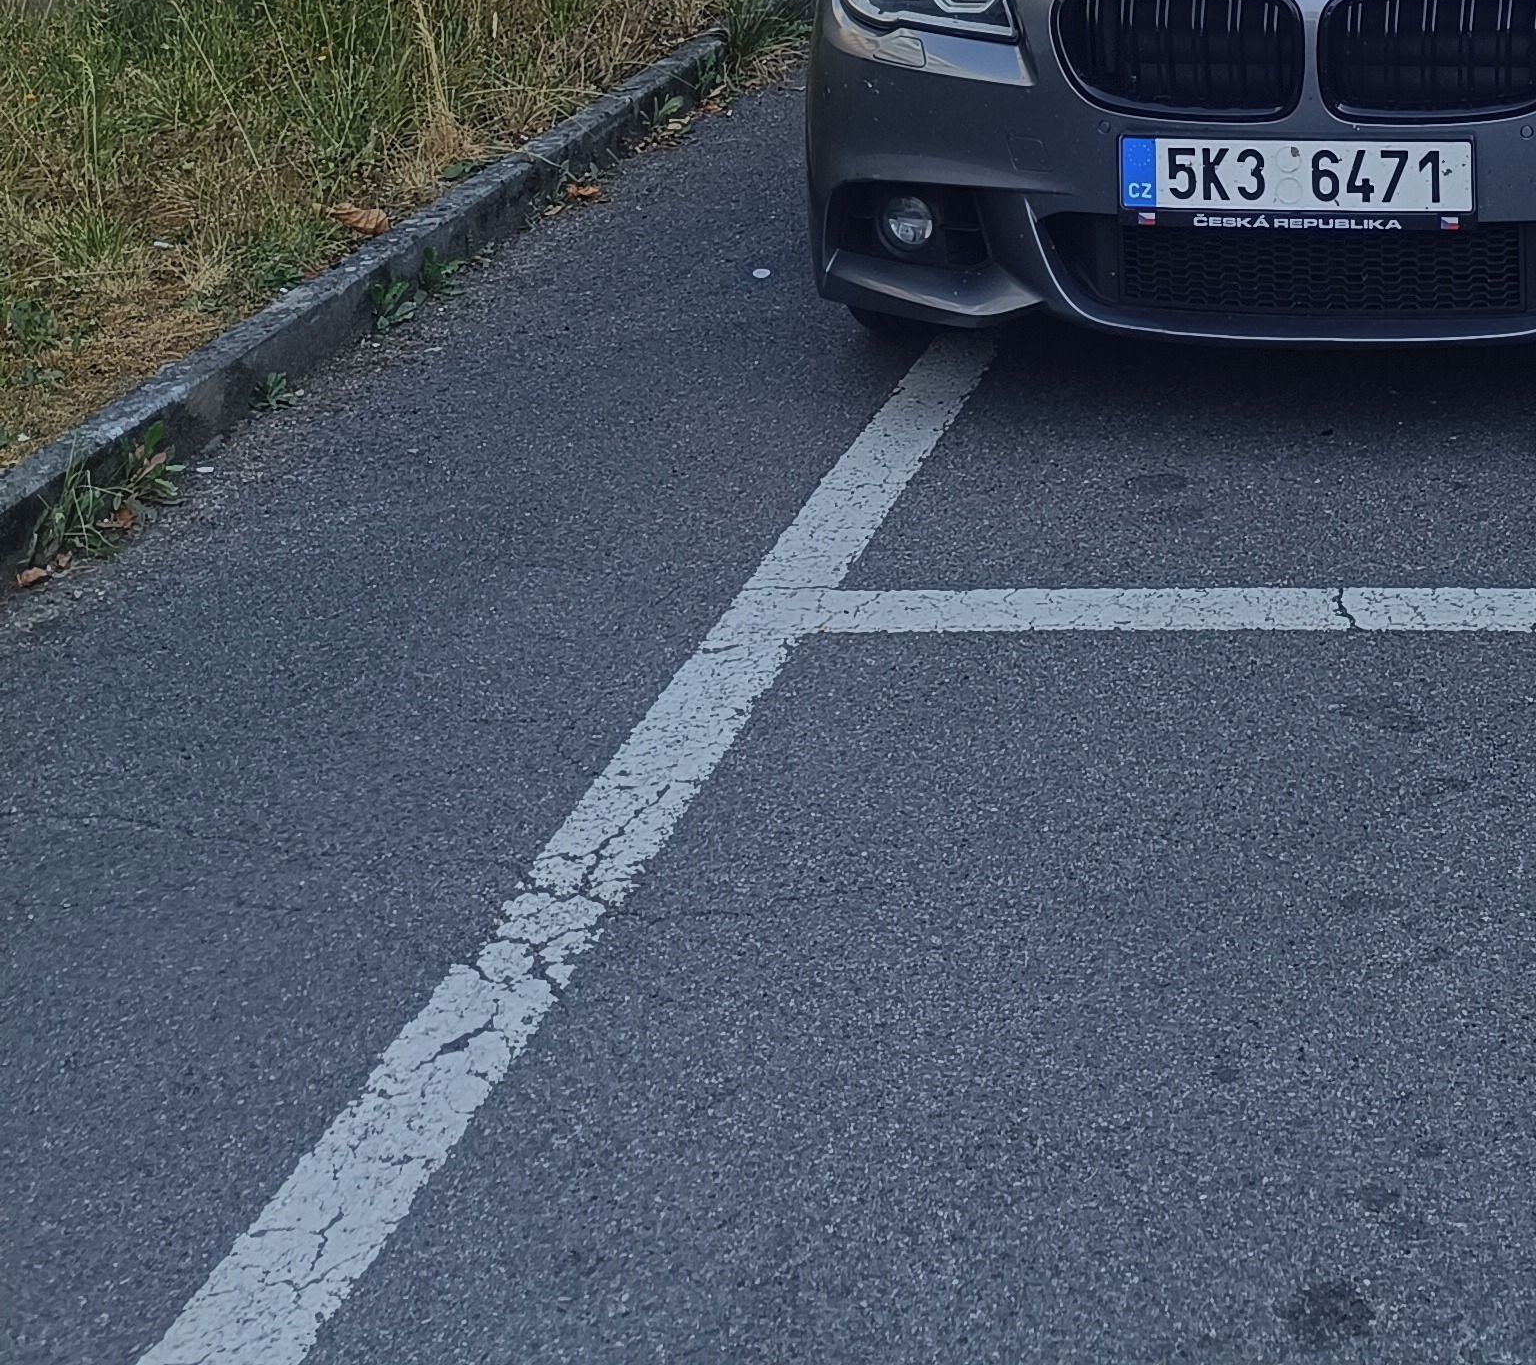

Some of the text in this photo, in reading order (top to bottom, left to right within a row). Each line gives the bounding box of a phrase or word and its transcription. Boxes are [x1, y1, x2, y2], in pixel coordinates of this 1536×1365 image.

[1167, 147, 1441, 204] 5K3 6471
[1127, 182, 1153, 199] CZ
[1193, 213, 1403, 230] ČESKÁ REPUBLIKA
